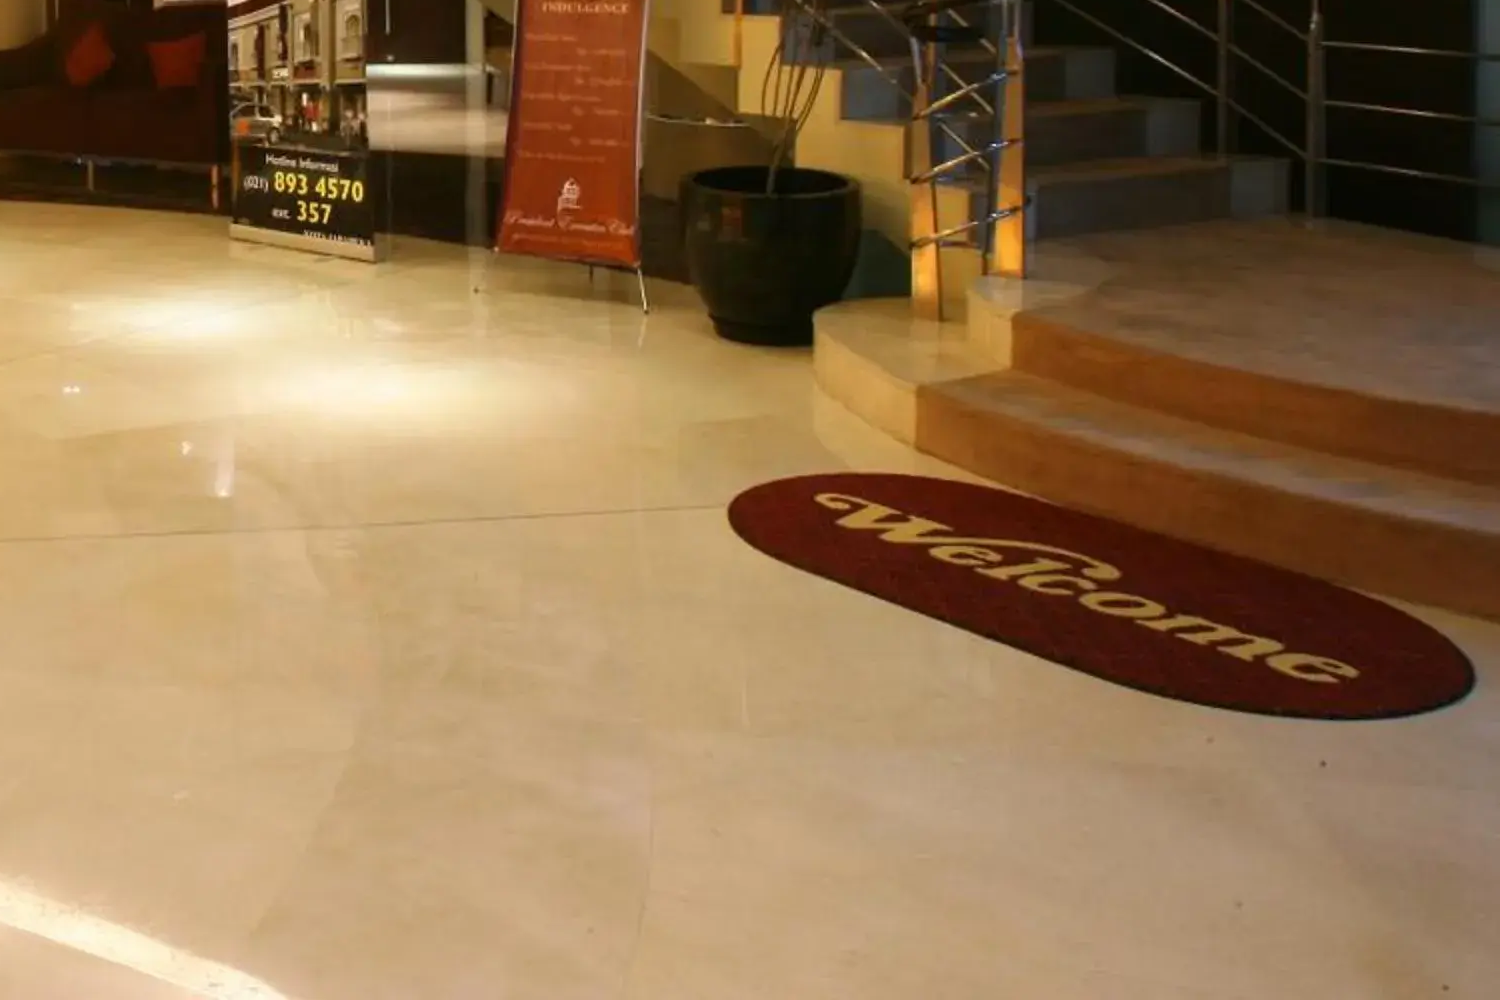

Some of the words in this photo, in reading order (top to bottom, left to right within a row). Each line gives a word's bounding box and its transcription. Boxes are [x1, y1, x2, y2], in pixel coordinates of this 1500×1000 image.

[542, 3, 630, 14] INDULGENCE
[274, 171, 308, 195] 893
[315, 175, 364, 202] 4570
[296, 200, 332, 225] 357
[813, 492, 1361, 684] Welcome
